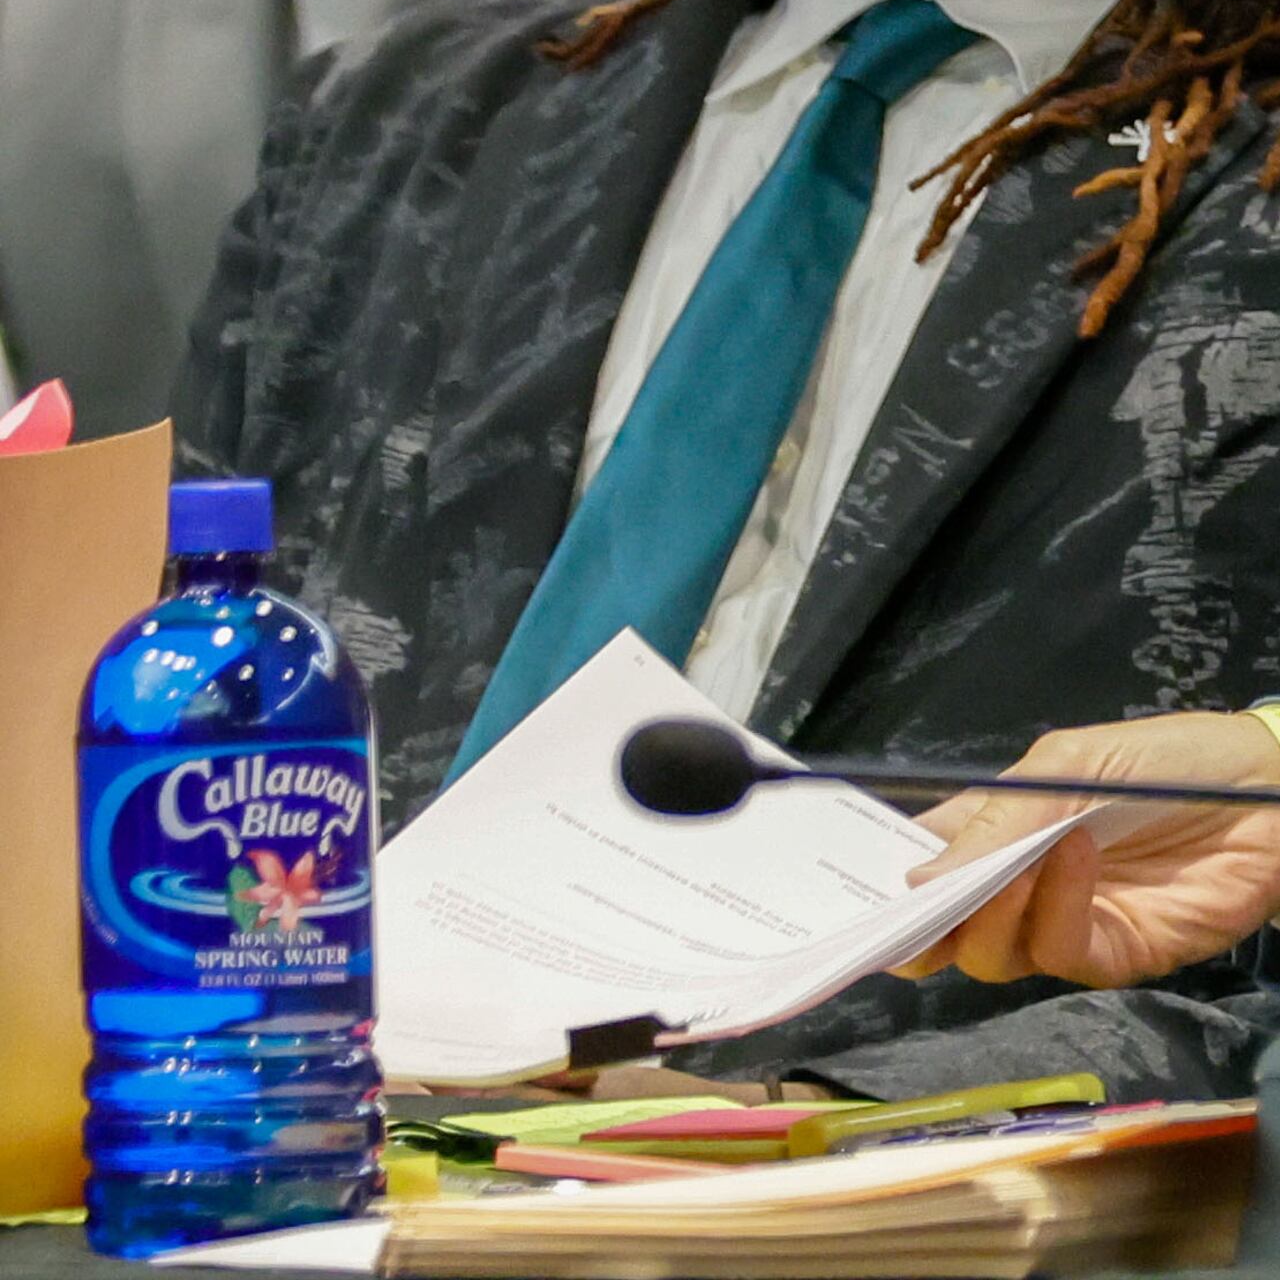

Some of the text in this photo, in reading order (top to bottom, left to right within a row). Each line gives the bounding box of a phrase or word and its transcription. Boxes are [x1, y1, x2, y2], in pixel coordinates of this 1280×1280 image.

[157, 754, 366, 858] Callaway
[239, 802, 321, 838] Blue
[230, 931, 324, 947] MOUNTAIN
[194, 947, 348, 969] SPRING WATER
